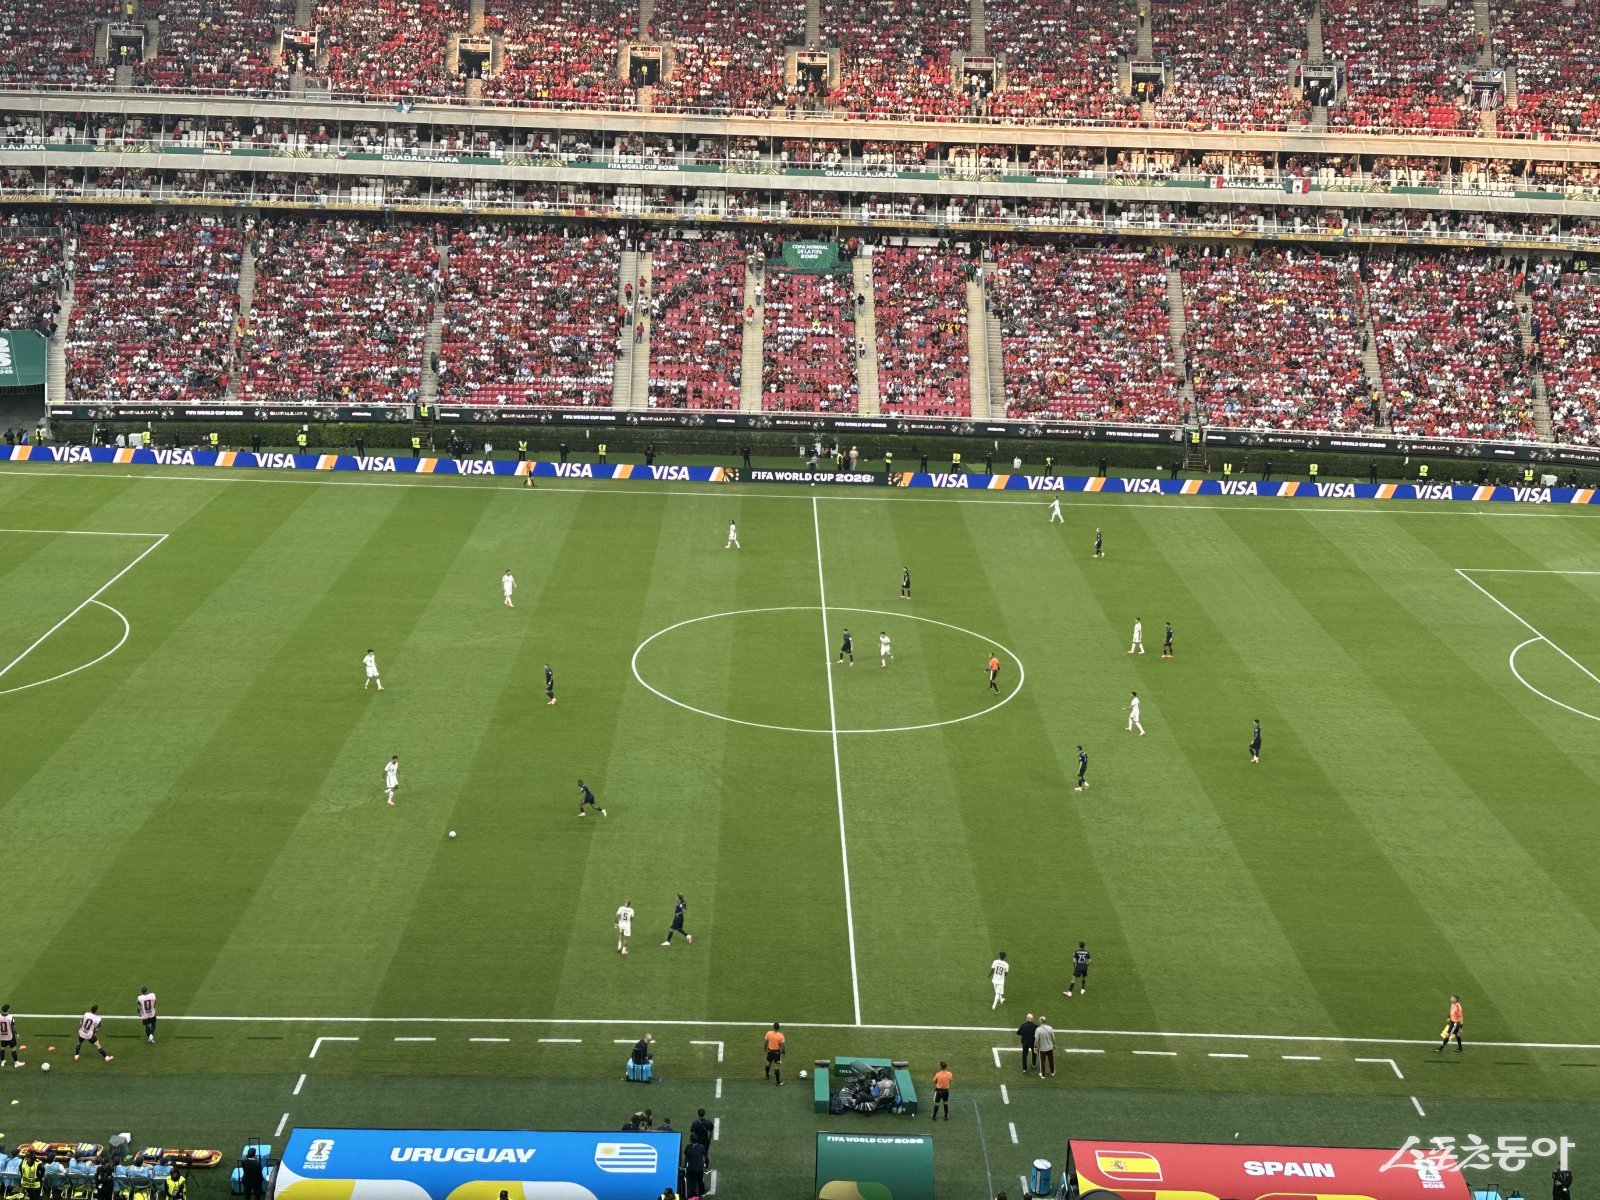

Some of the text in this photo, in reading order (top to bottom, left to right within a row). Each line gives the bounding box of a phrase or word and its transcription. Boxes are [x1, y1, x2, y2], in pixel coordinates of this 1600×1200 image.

[382, 154, 459, 163] GUADALAJARA
[1222, 182, 1284, 190] ADALAJARA
[48, 446, 93, 462] VISA
[150, 449, 195, 465] VISA
[252, 453, 296, 468] VISA
[352, 455, 396, 472] VISA
[452, 459, 495, 475] VISA
[551, 462, 593, 478] VISA
[648, 465, 690, 480] VISA
[752, 471, 774, 480] FIFA
[774, 472, 812, 481] WORLD
[814, 473, 835, 482] CUP
[926, 473, 969, 488] VISA
[1023, 476, 1065, 491] VISA
[1120, 478, 1161, 493] VISA
[1217, 480, 1258, 496] VISA
[1312, 482, 1356, 498] VISA
[1411, 484, 1454, 500] VISA
[1509, 486, 1552, 502] VISA
[390, 1147, 537, 1163] URUGUAY
[1243, 1160, 1336, 1178] SPAIN
